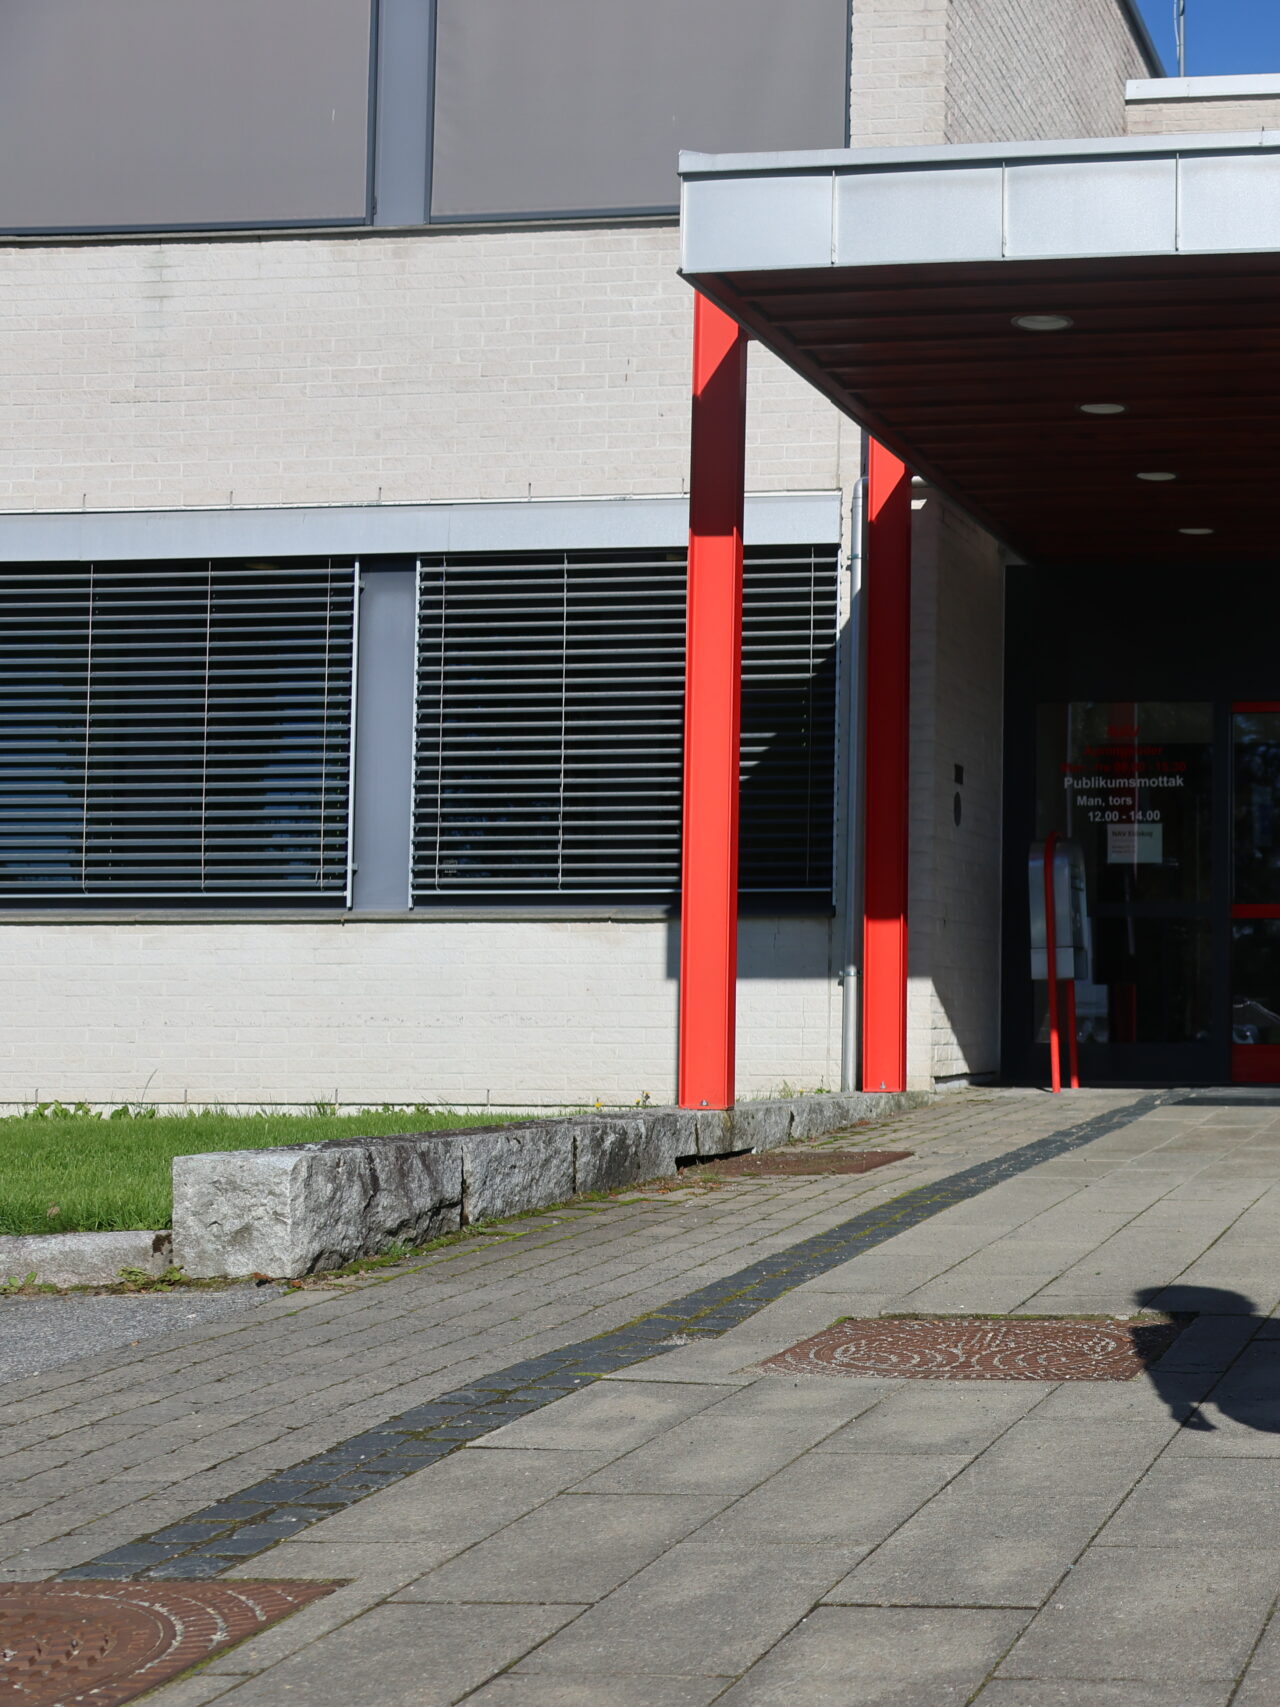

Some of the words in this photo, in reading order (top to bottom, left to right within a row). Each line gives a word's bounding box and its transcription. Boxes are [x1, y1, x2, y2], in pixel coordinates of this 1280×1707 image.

[1064, 775, 1184, 789] Publikumsmottak
[1077, 795, 1105, 807] Man,
[1109, 796, 1133, 806] tors
[1088, 811, 1119, 822] 12.00
[1130, 810, 1161, 821] 14.00
